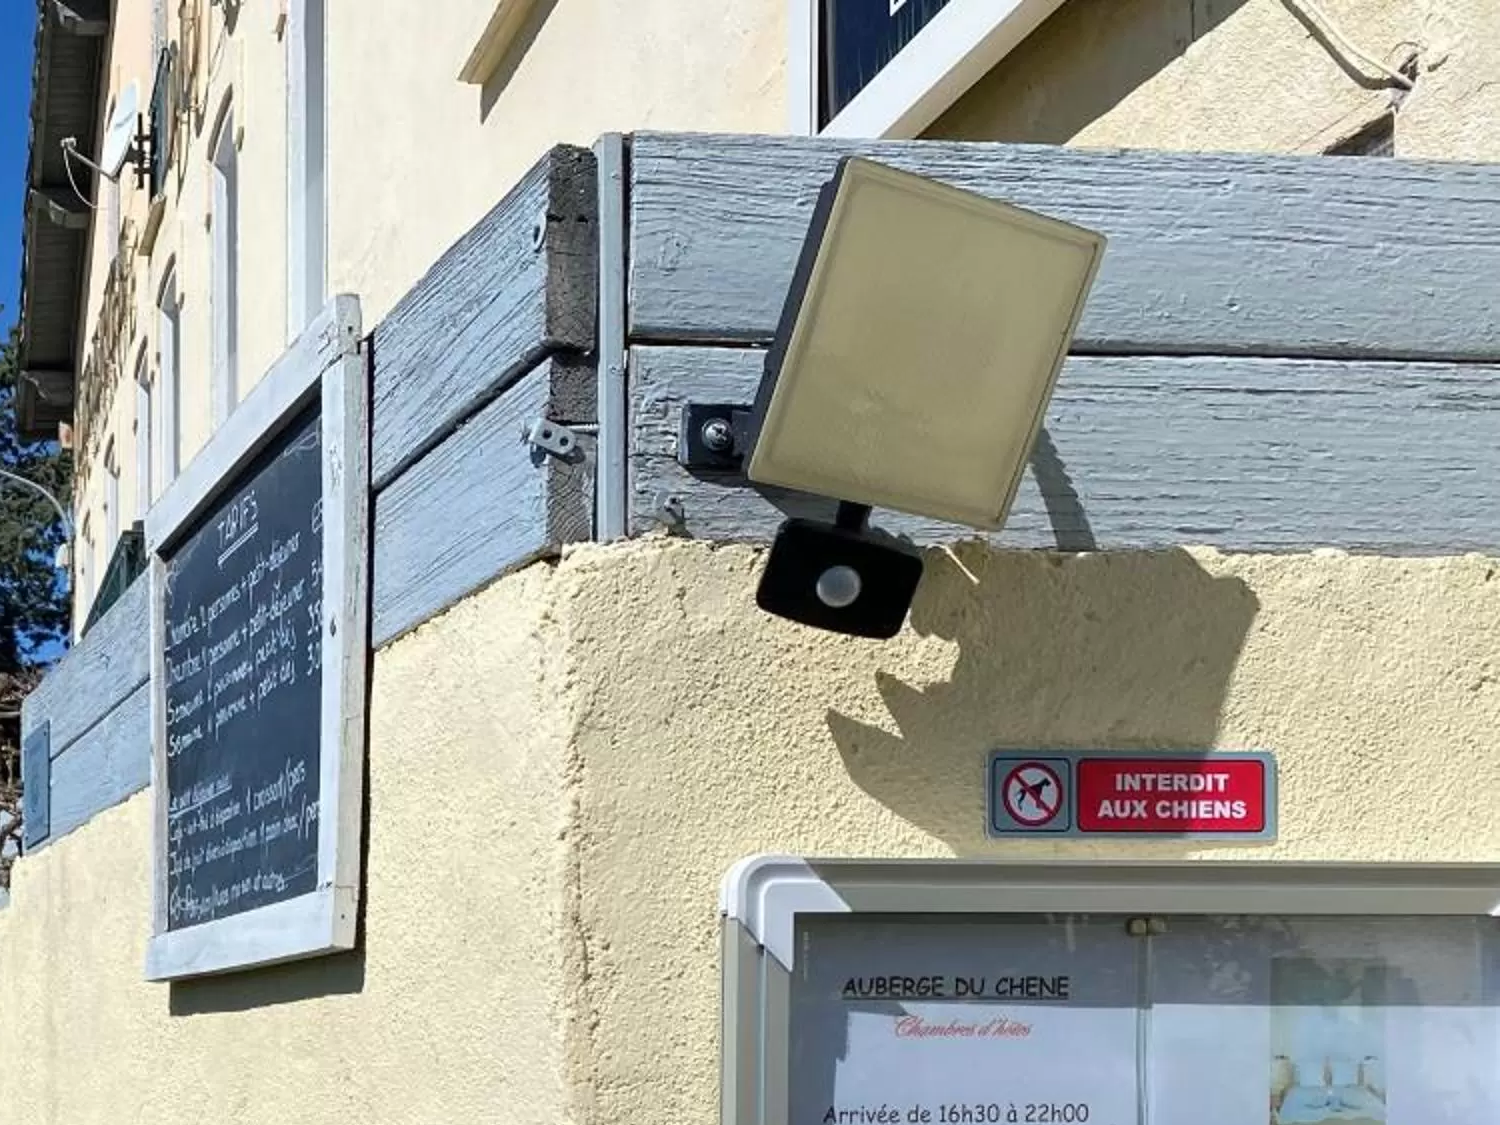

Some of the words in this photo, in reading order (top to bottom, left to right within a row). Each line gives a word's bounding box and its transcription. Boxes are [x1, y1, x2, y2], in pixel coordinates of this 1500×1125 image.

[218, 489, 258, 549] TARIFS
[1115, 773, 1230, 792] INTERDIT
[1097, 801, 1148, 819] AUX
[1155, 800, 1247, 819] CHIENS
[842, 976, 944, 997] AUBERGE
[955, 976, 985, 997] DU
[995, 976, 1070, 997] CHENE
[895, 1015, 975, 1039] Chambres
[823, 1103, 901, 1125] Arrivée
[907, 1103, 931, 1124] de
[938, 1103, 1000, 1124] 16h30
[1006, 1102, 1018, 1124] à
[1024, 1103, 1090, 1124] 22h00
